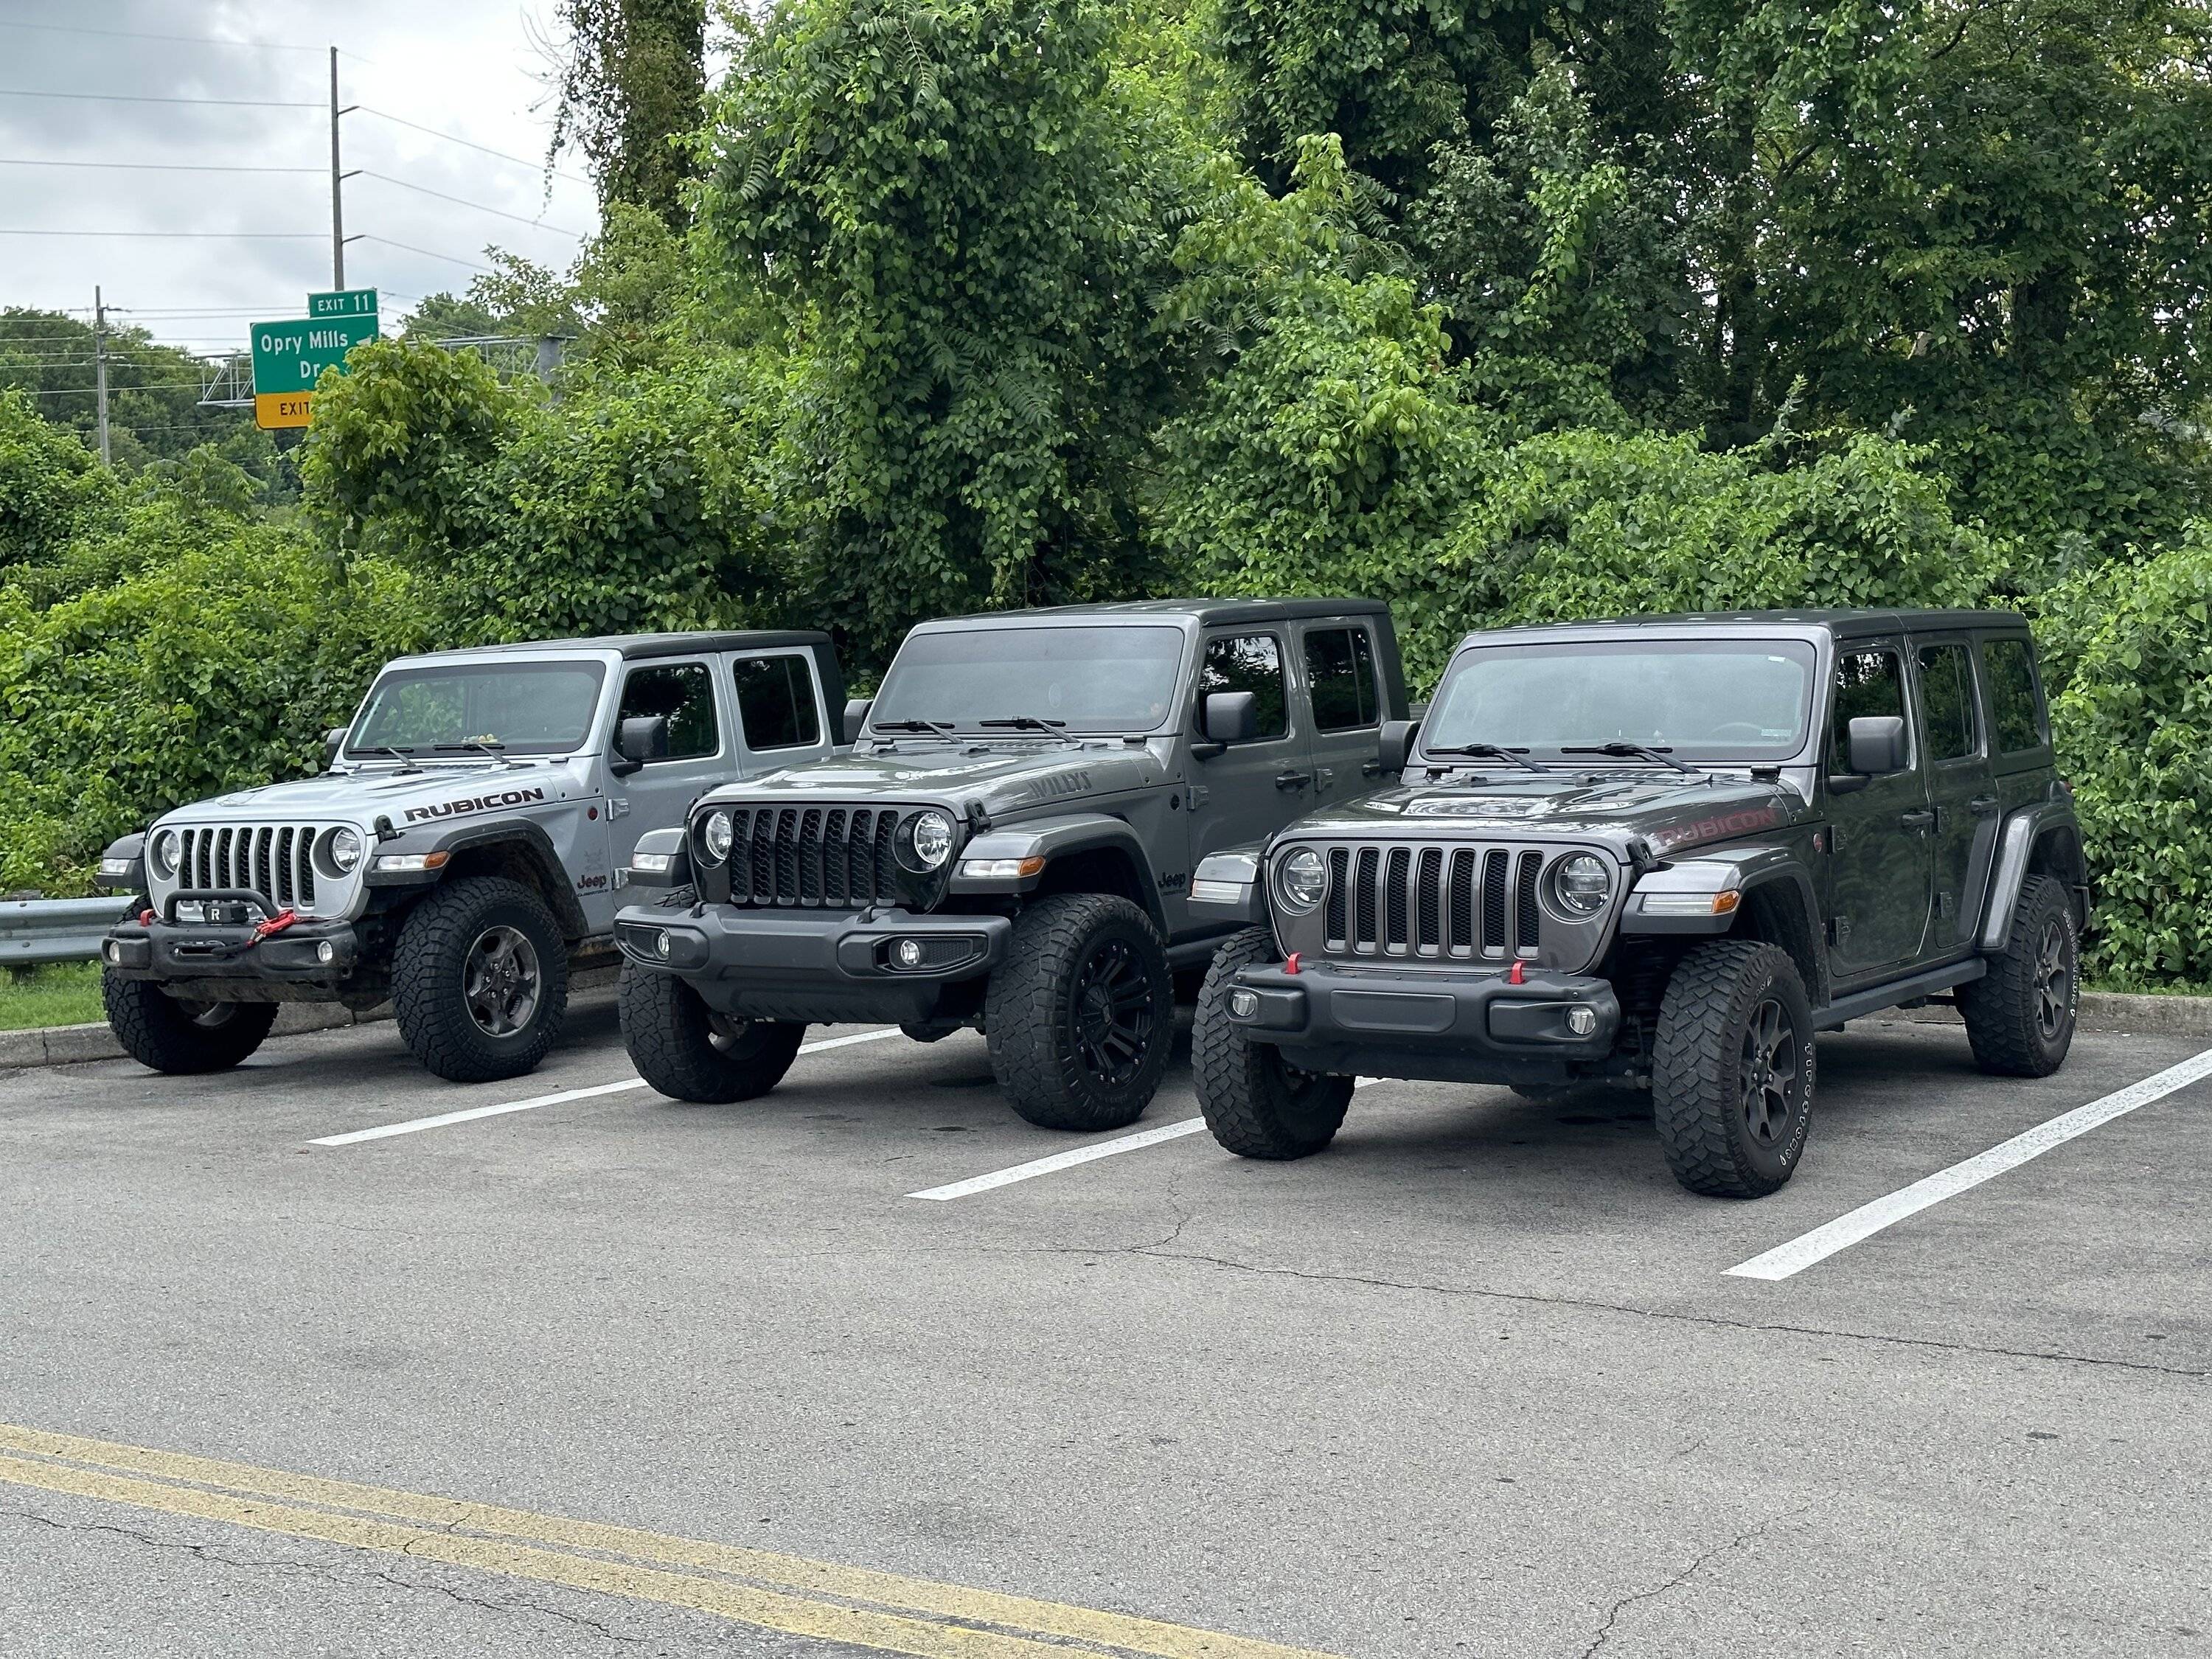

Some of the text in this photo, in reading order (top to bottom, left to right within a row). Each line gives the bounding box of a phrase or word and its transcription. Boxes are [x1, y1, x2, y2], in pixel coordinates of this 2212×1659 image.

[318, 294, 369, 312] EXIT 11
[261, 330, 348, 355] Opry Mills
[300, 361, 321, 378] Dr
[280, 401, 310, 415] EXIT
[1028, 771, 1093, 798] WILLYS
[404, 787, 544, 821] RUBICON
[1657, 808, 1776, 846] RUBICON
[577, 874, 607, 889] Jeep
[1158, 872, 1186, 888] Jeep
[211, 908, 220, 920] R
